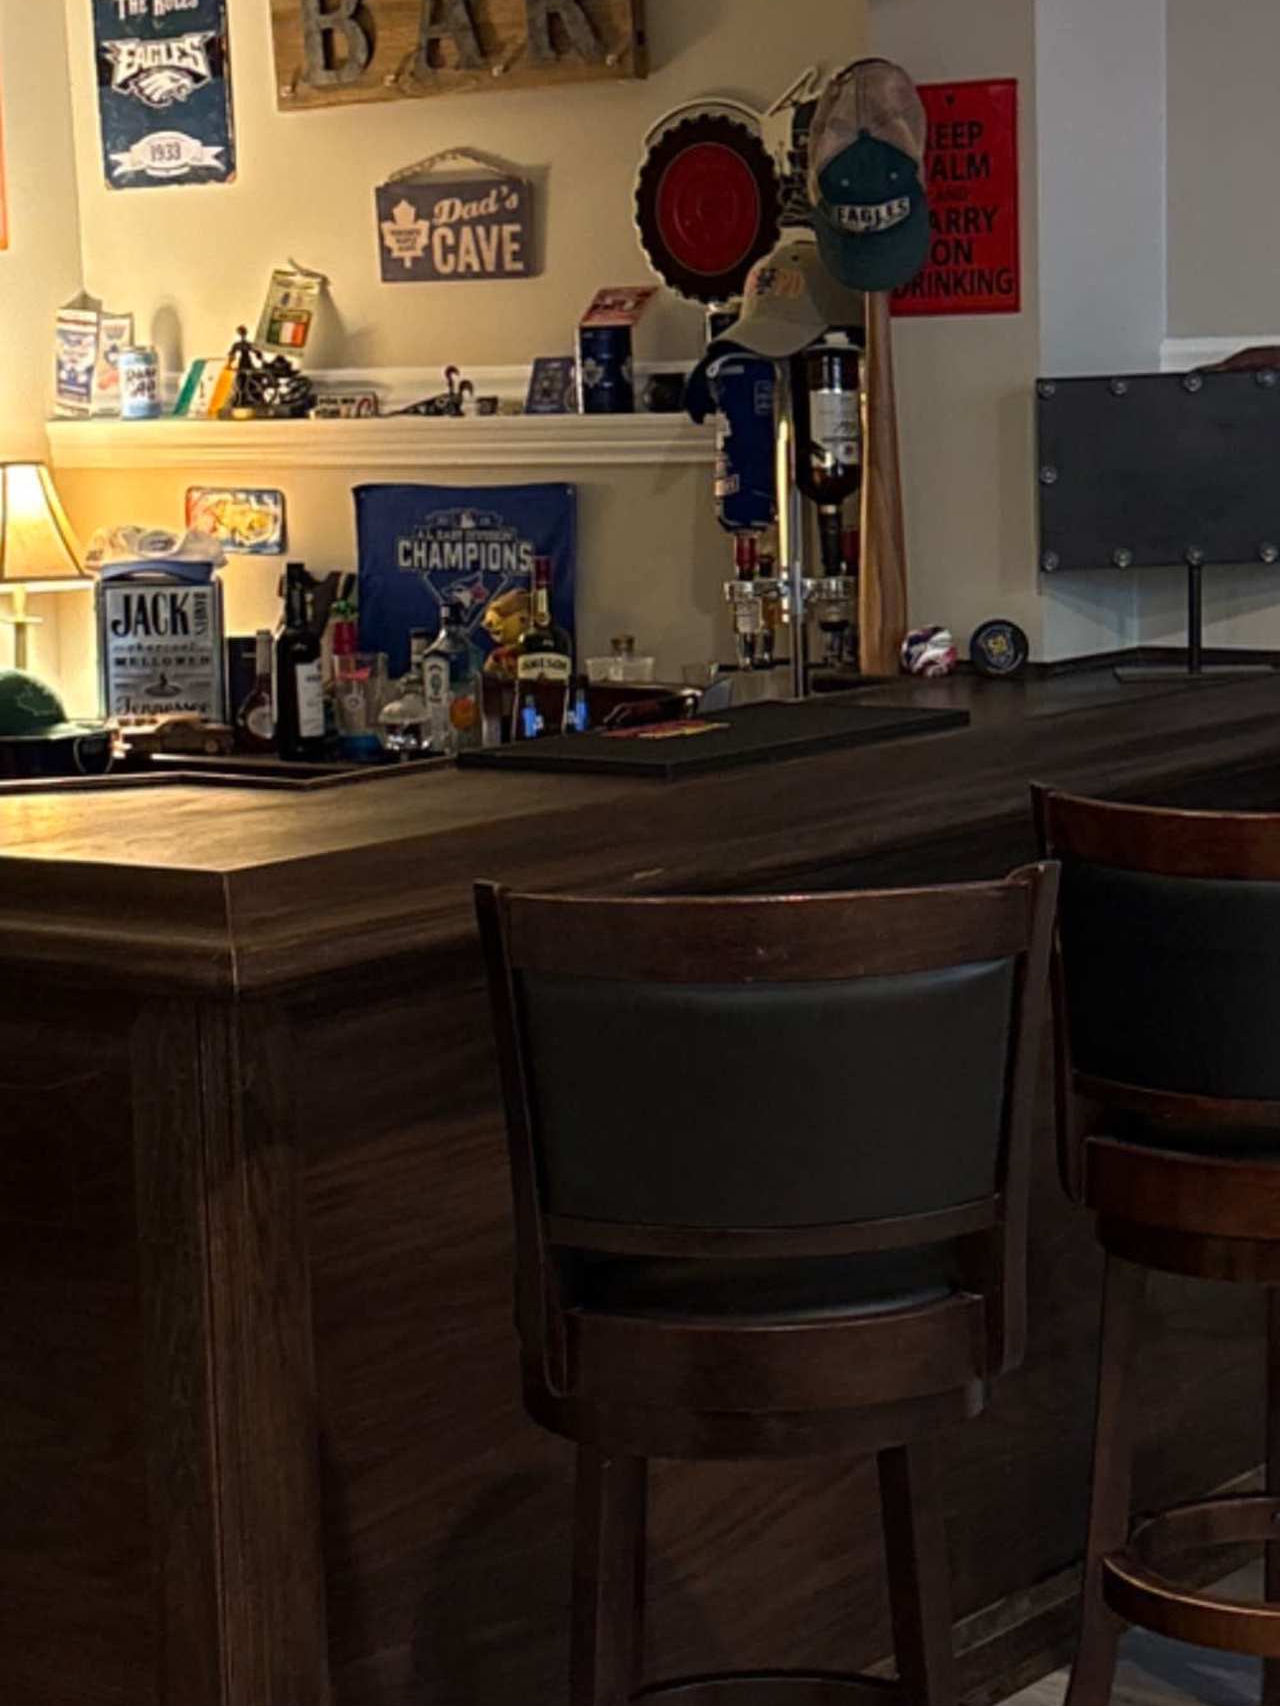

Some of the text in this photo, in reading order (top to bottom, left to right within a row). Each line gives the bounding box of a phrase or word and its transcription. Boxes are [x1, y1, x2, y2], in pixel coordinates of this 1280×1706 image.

[108, 34, 208, 72] EAGLES
[150, 144, 181, 162] 1933
[930, 153, 991, 181] ALM
[432, 185, 518, 225] Dad's
[838, 197, 909, 223] EAGLES
[929, 207, 999, 234] ARRY
[431, 223, 524, 275] CAVE
[931, 240, 973, 266] ON
[398, 540, 534, 571] CHAMPIONS
[111, 592, 190, 637] JACK
